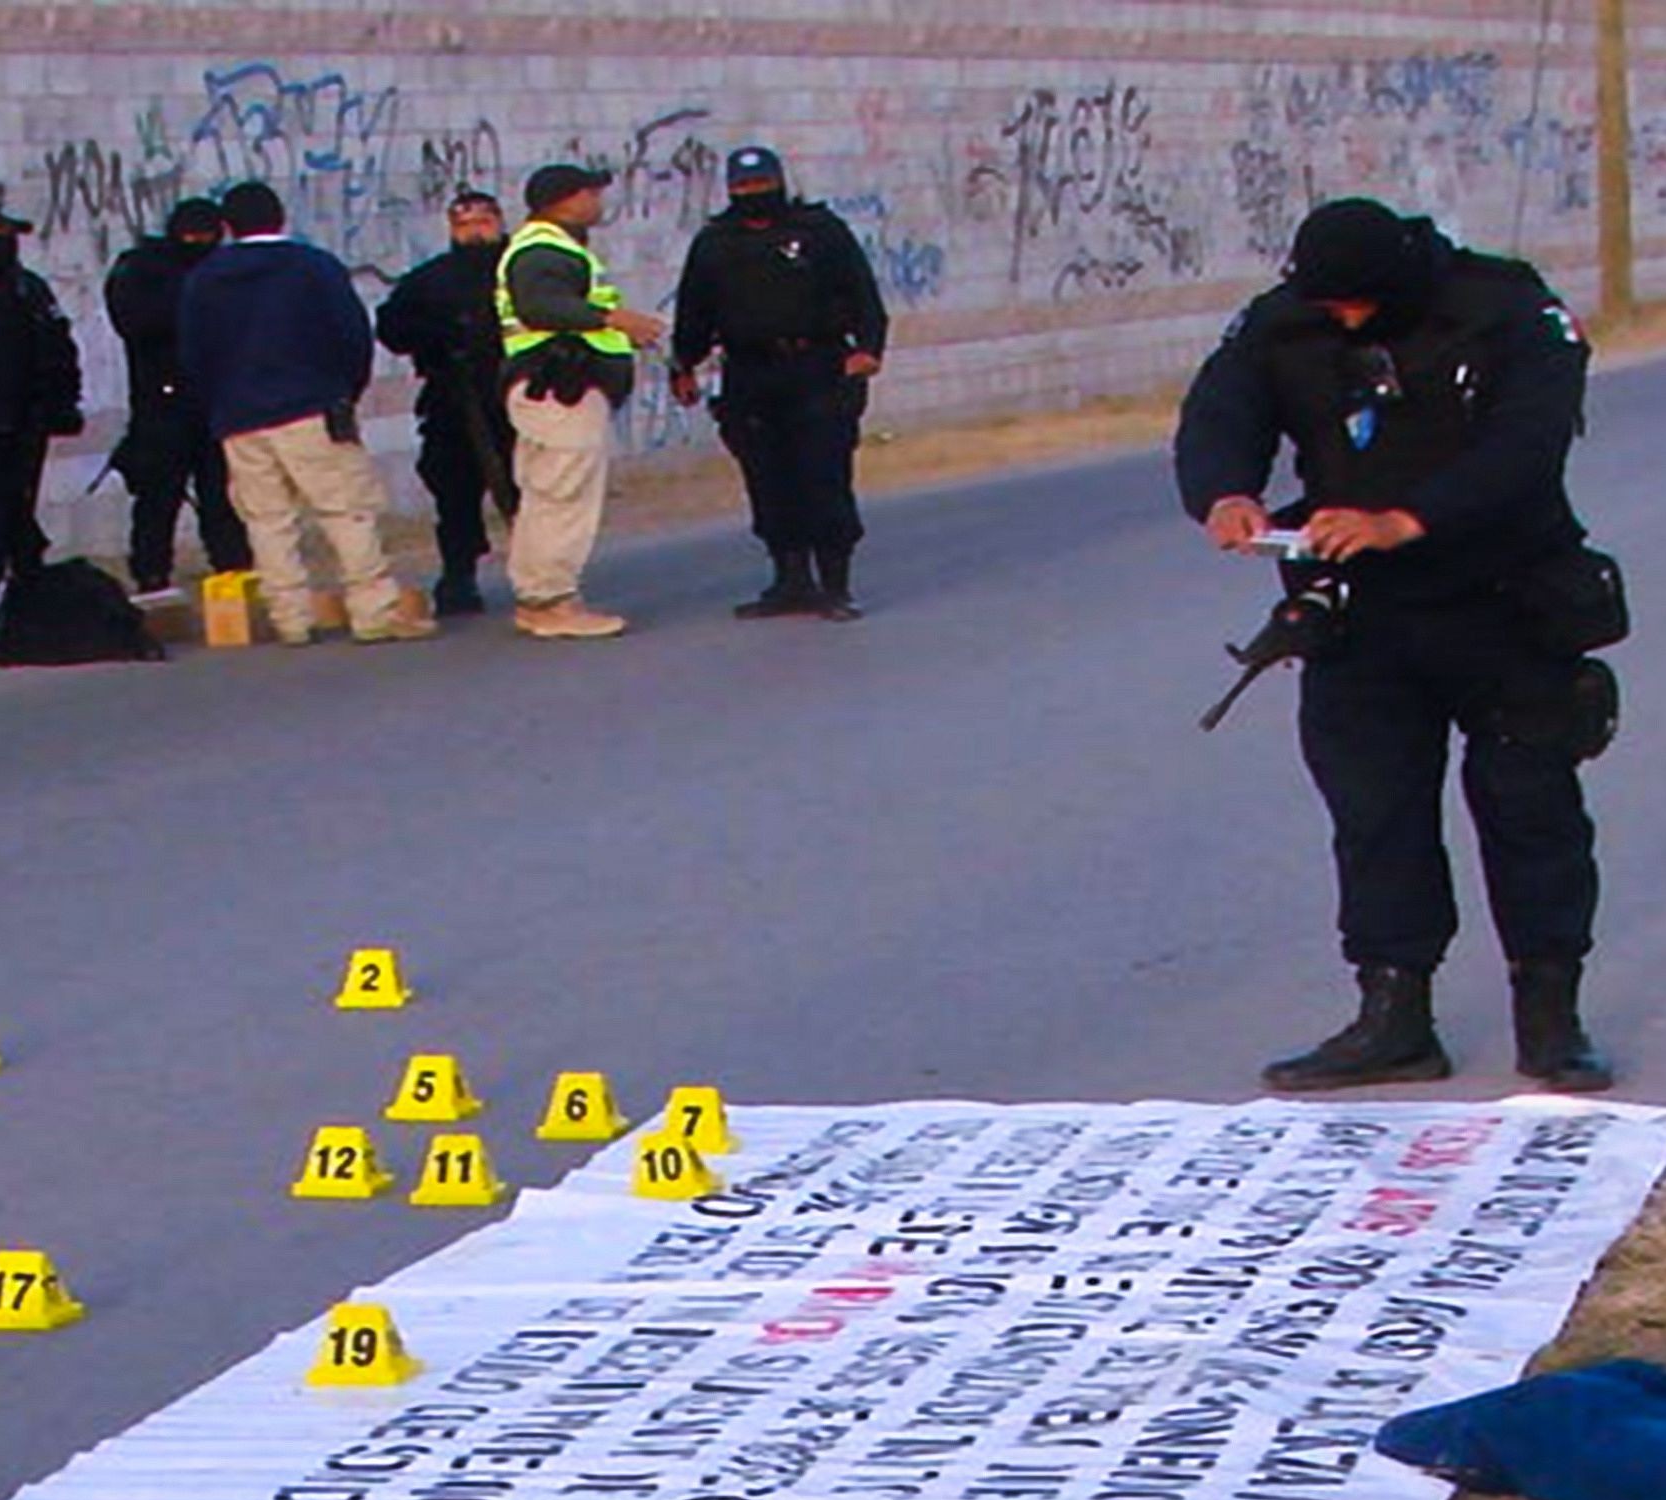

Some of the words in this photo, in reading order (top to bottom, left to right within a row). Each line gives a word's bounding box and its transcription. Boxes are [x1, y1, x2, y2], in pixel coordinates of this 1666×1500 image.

[361, 963, 381, 993] 2
[413, 1070, 436, 1103] 5
[565, 1088, 589, 1122] 6
[681, 1105, 703, 1137] 7
[314, 1146, 358, 1180] 12
[433, 1150, 473, 1184] 11
[641, 1146, 683, 1183] 10
[328, 1327, 378, 1368] 19
